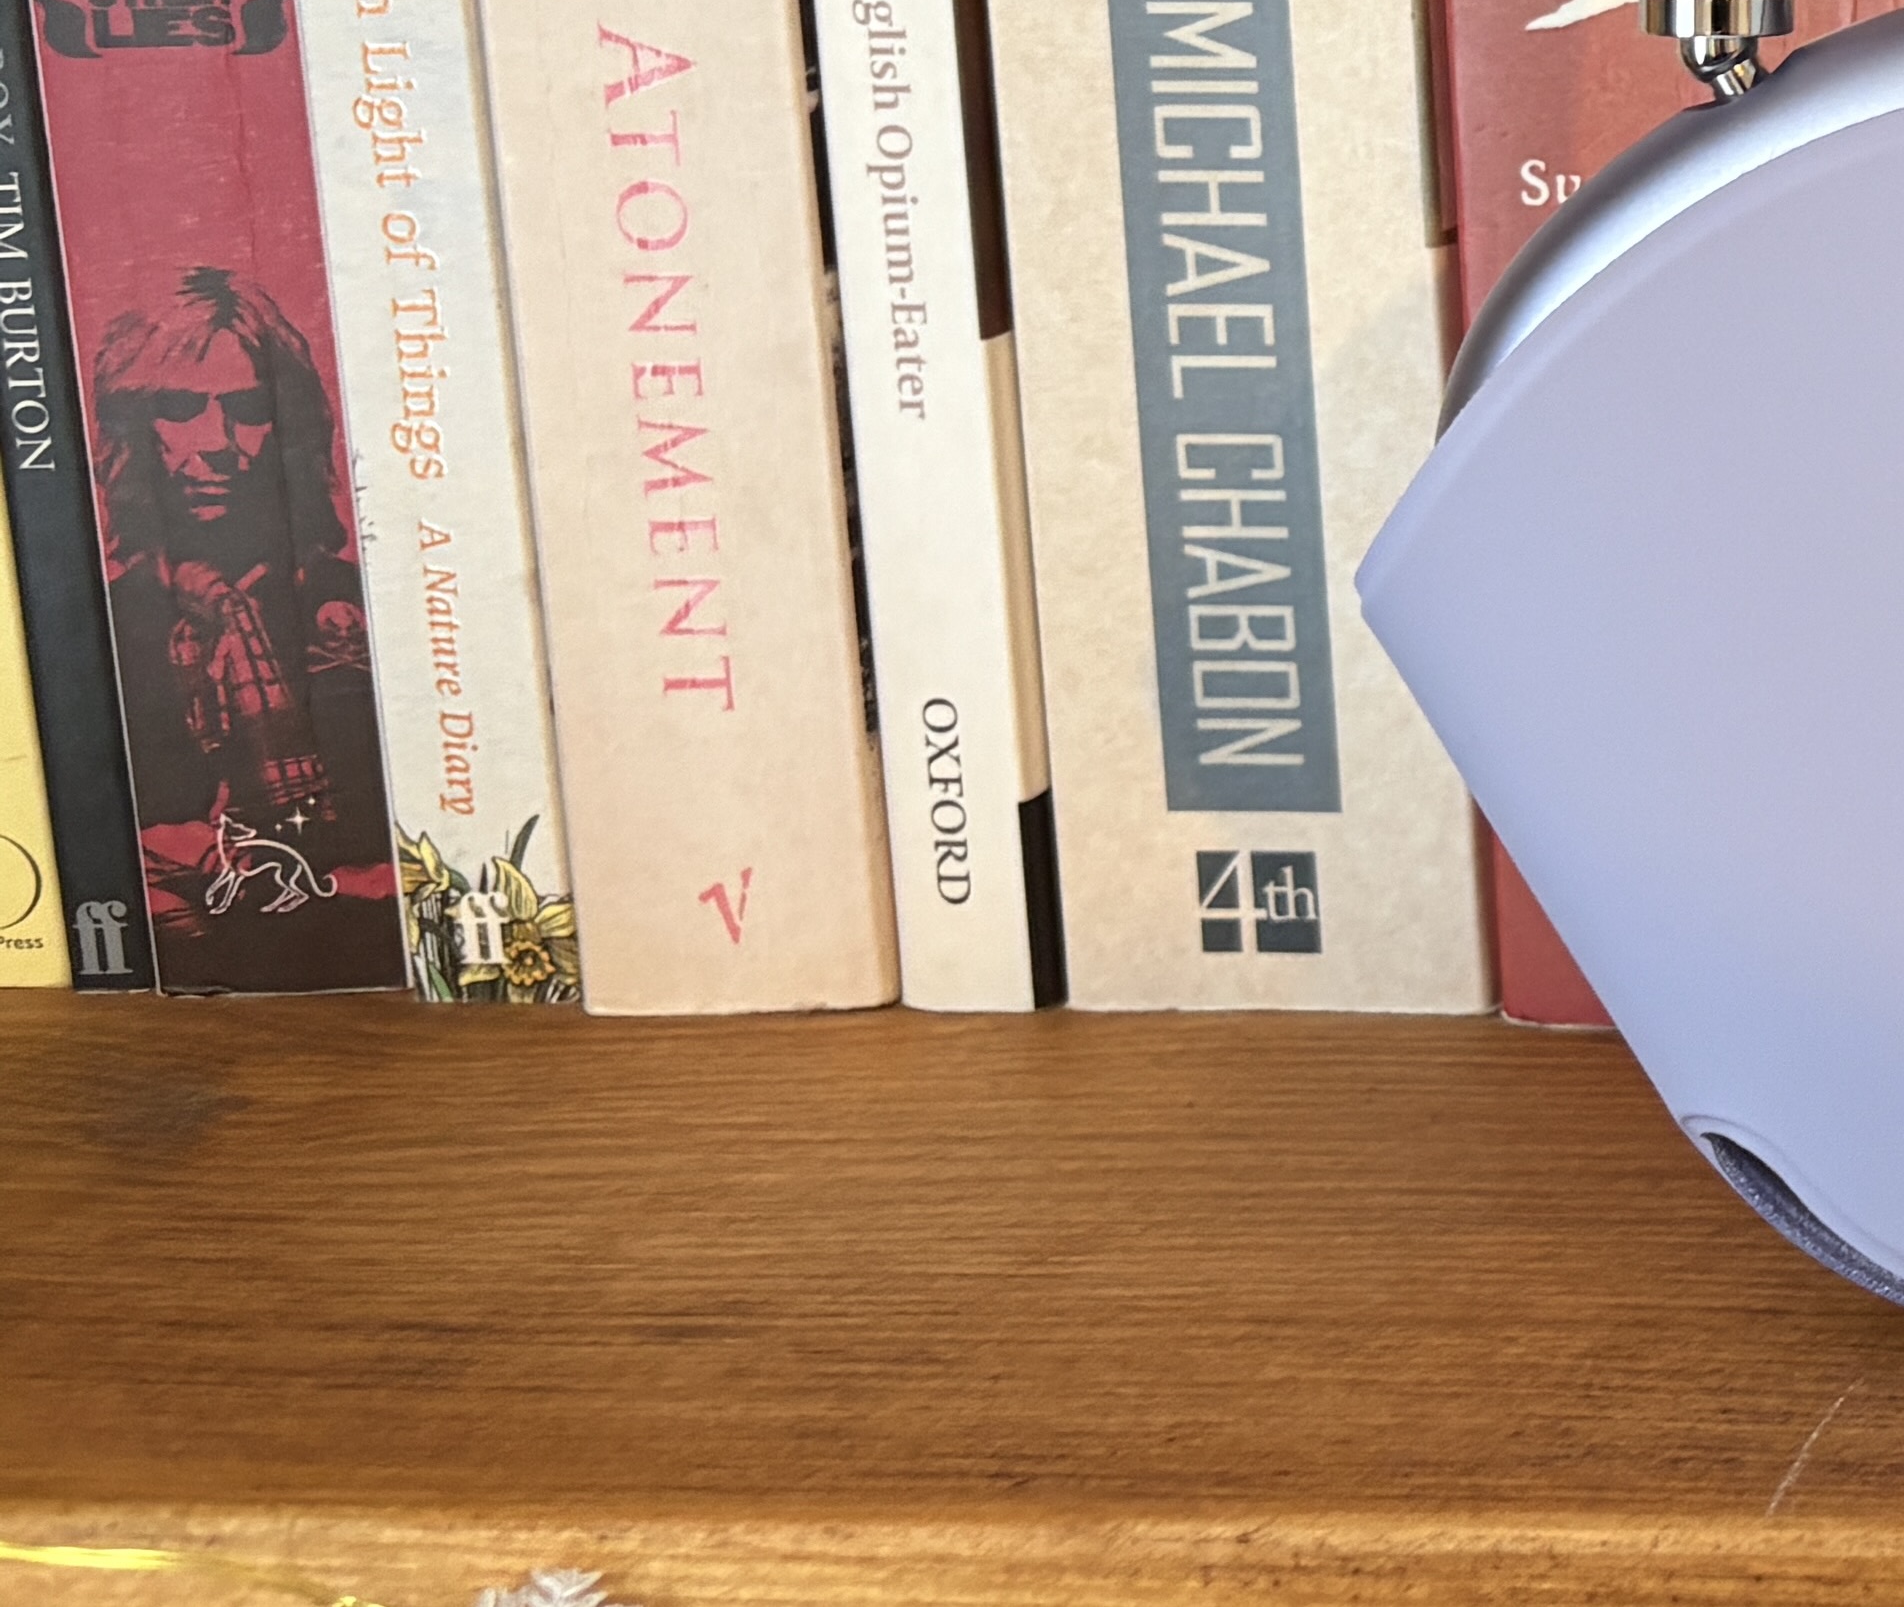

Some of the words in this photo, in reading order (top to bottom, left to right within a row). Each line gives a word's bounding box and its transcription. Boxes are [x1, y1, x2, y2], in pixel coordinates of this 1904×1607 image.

[351, 39, 426, 188] Light
[1146, 0, 1278, 400] MICHAEL
[380, 209, 438, 270] of
[865, 121, 929, 421] Opium-Eater
[0, 277, 55, 472] BURTON
[390, 292, 446, 479] Things
[597, 19, 736, 713] ATONEMENT
[418, 520, 450, 550] A
[1174, 432, 1306, 767] CHABON
[422, 566, 461, 697] Nature
[439, 709, 477, 817] Diary
[921, 696, 972, 907] OXFORD
[1197, 850, 1321, 952] 4th
